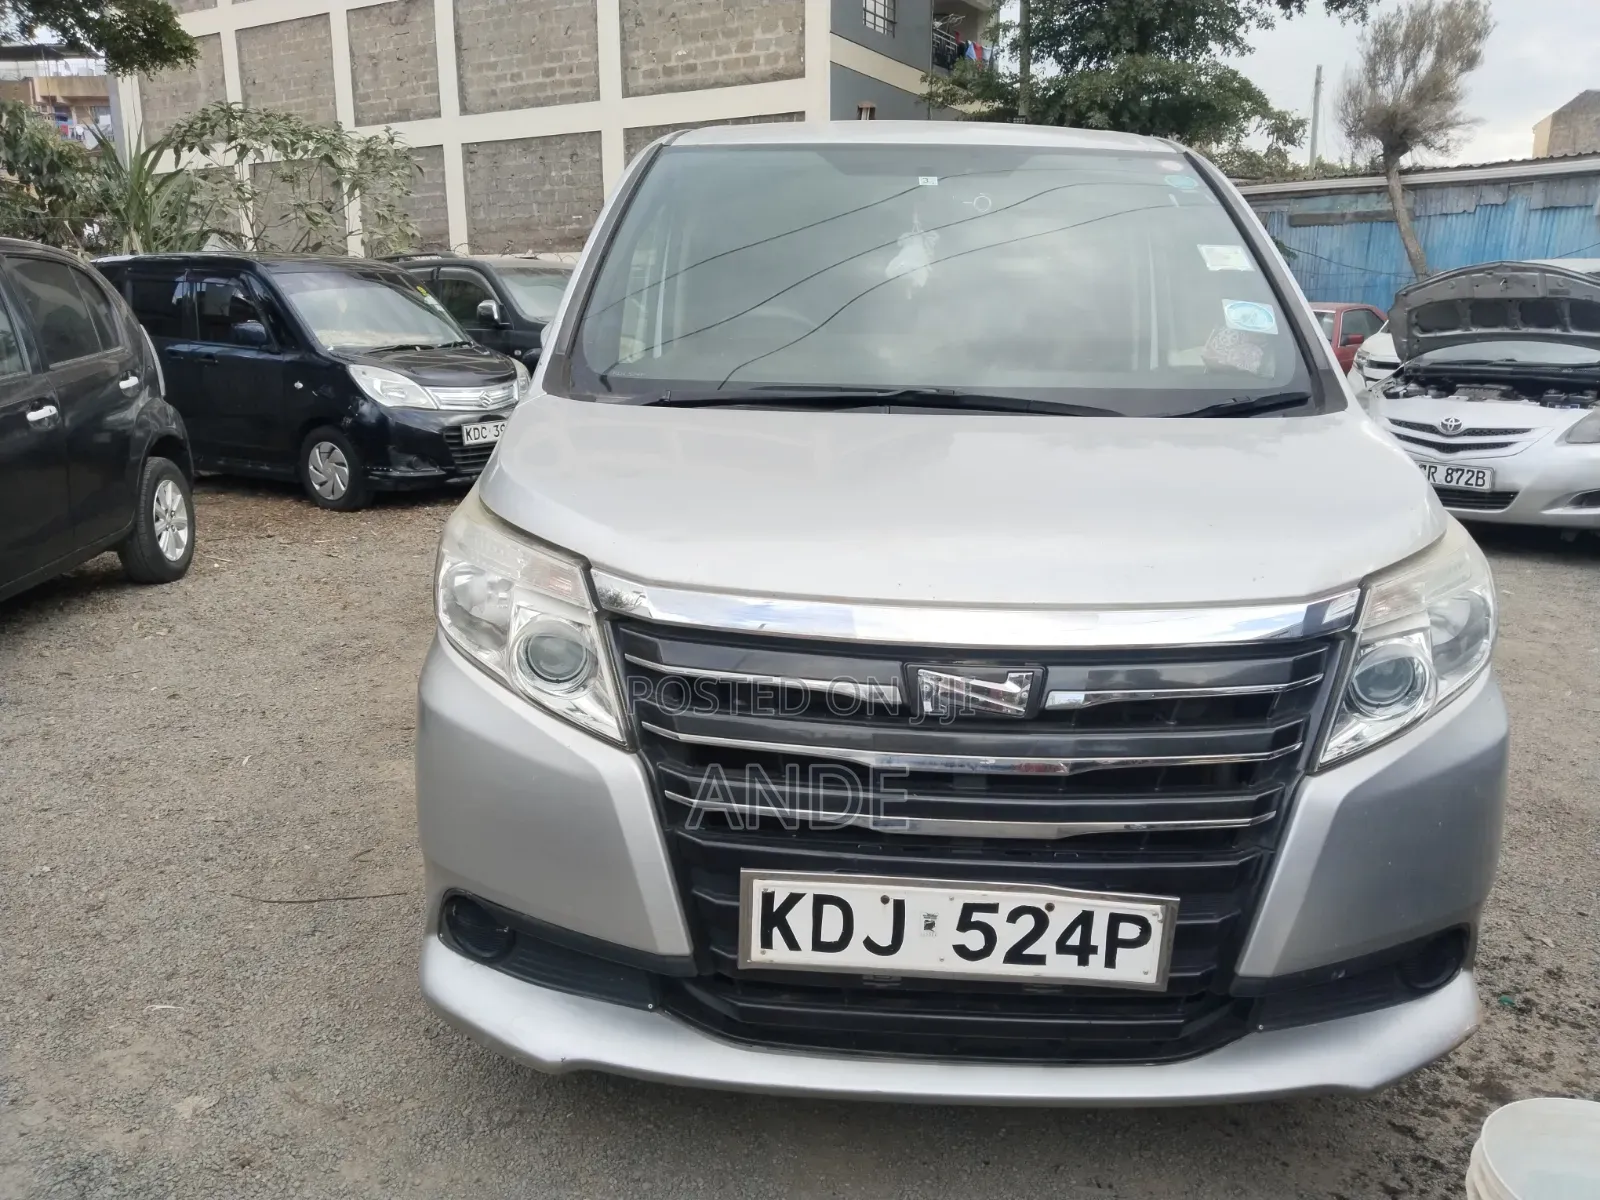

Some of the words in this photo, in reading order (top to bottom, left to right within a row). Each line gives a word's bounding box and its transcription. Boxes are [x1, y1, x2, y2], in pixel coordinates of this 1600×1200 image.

[465, 426, 488, 441] KDC
[1444, 467, 1486, 488] 872B
[759, 890, 907, 957] KDJ
[951, 901, 1153, 970] 524P
